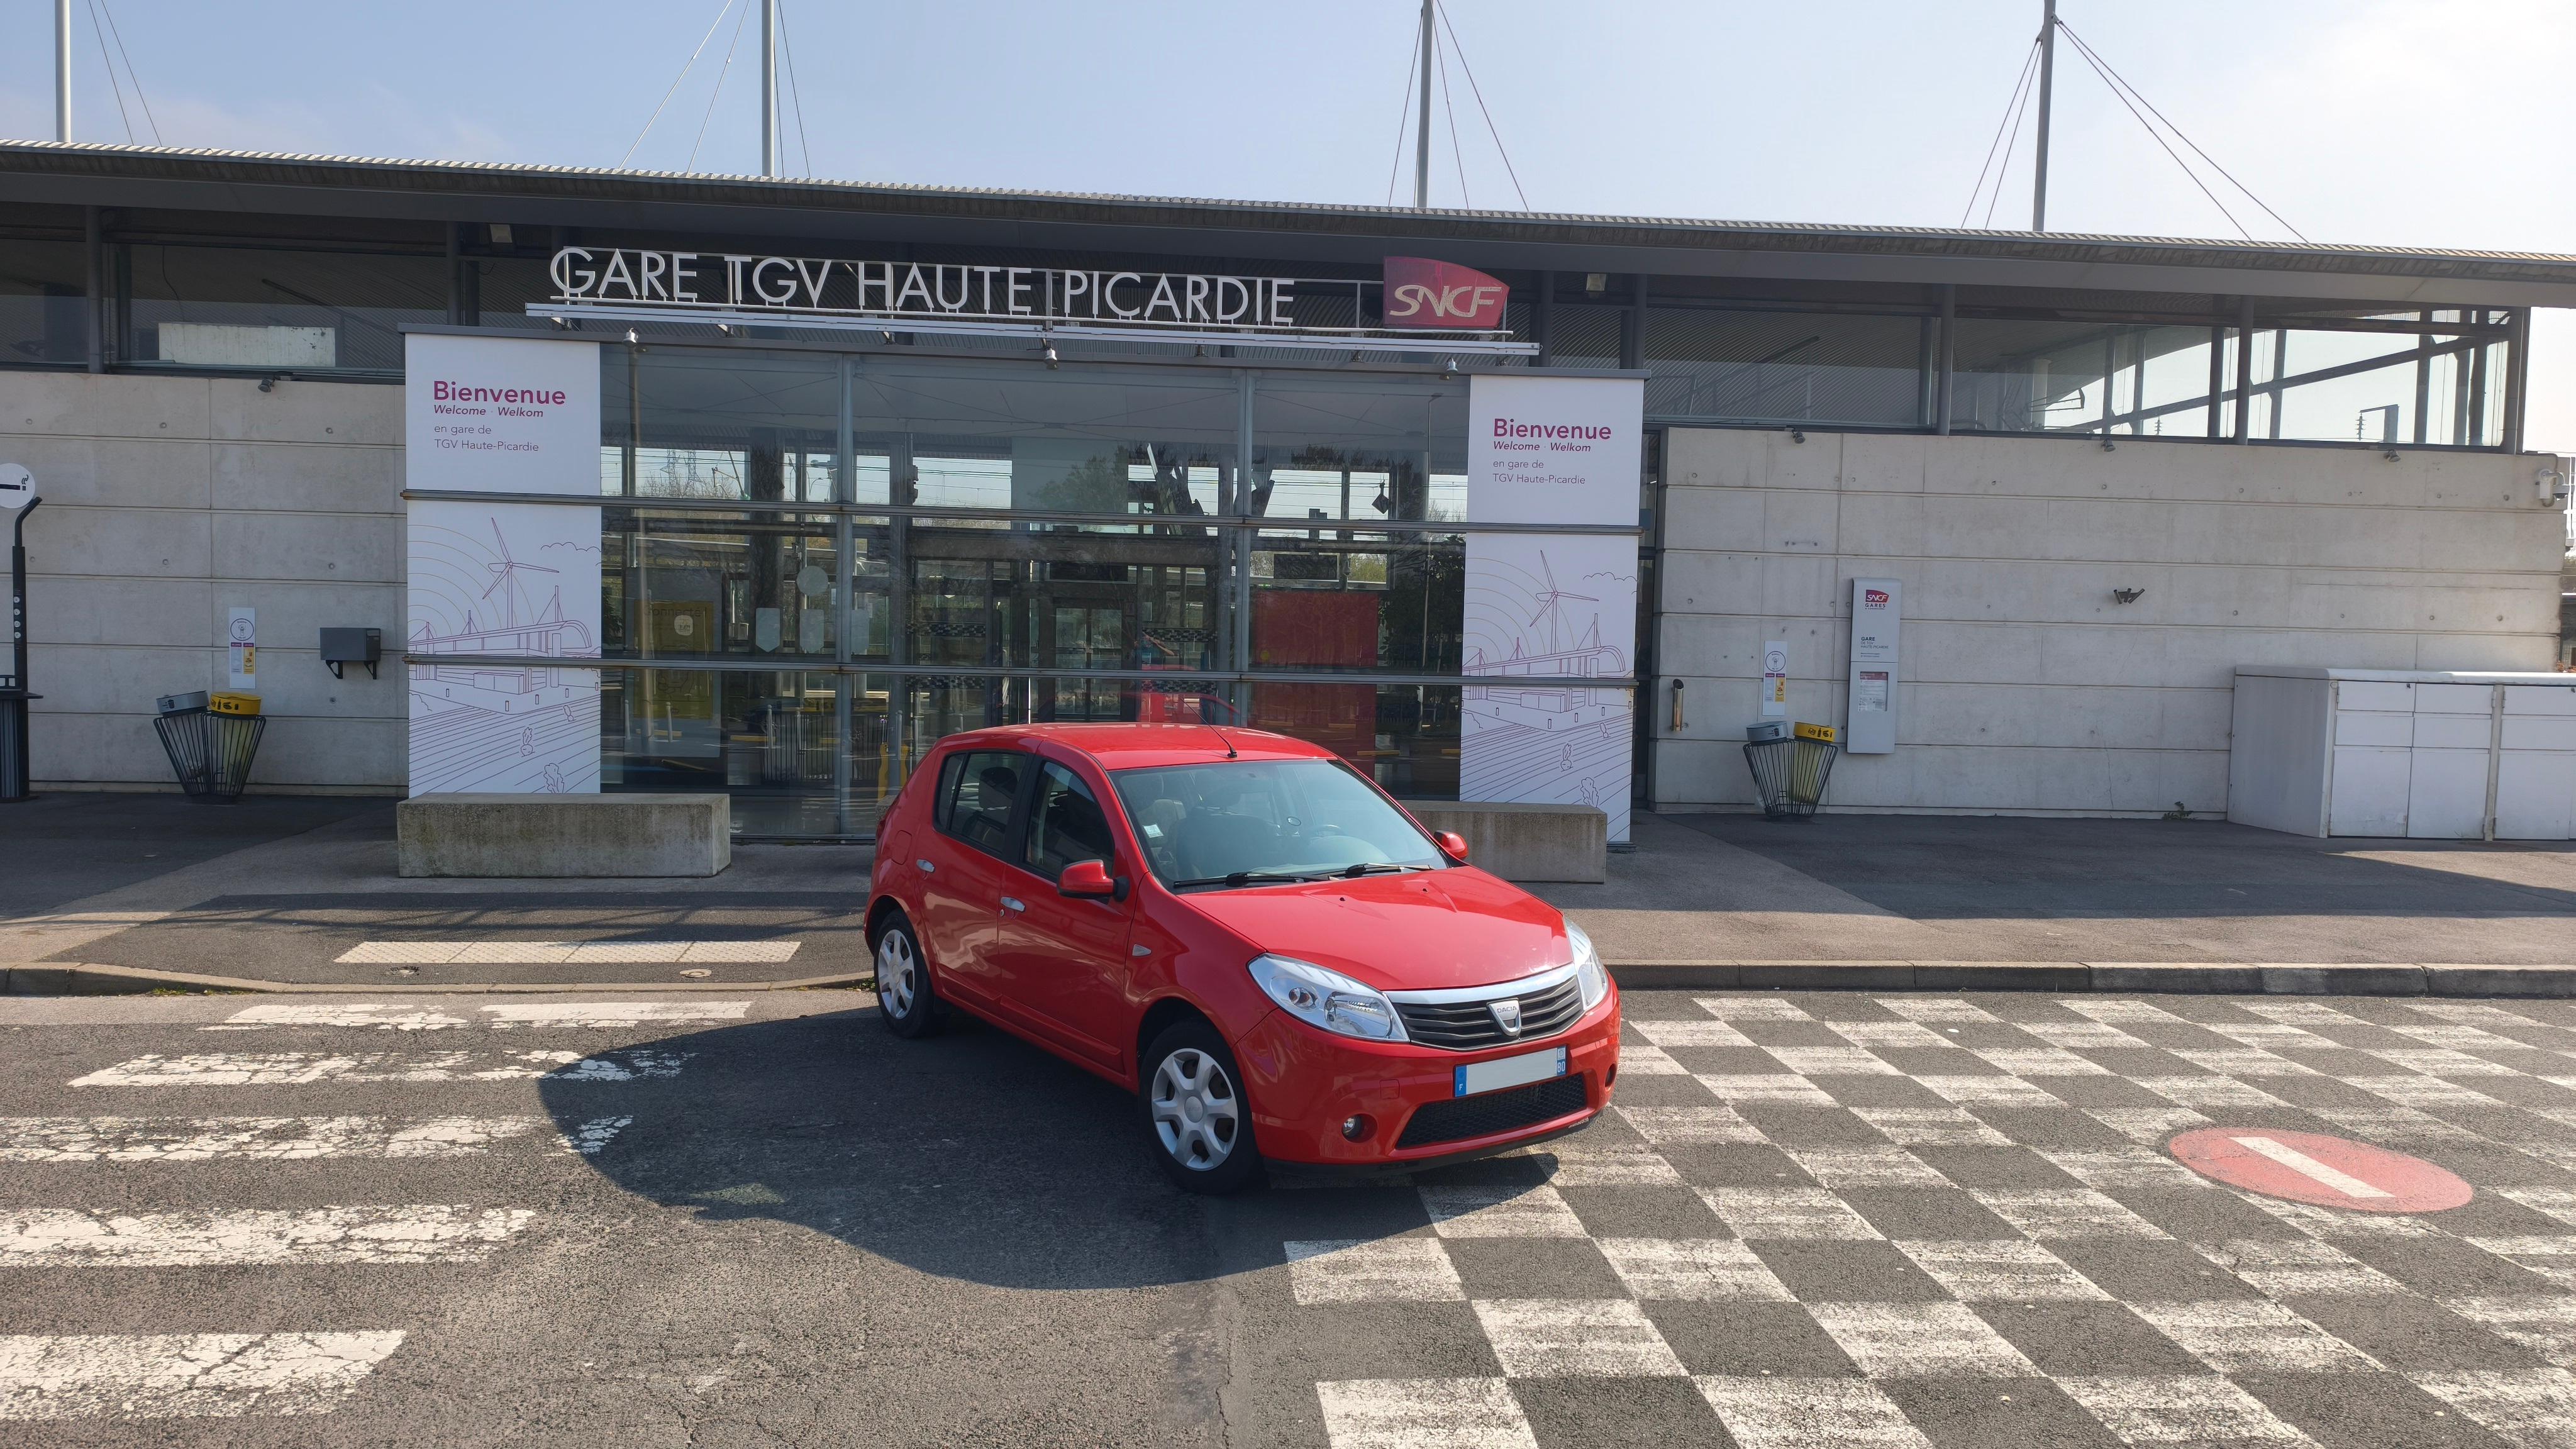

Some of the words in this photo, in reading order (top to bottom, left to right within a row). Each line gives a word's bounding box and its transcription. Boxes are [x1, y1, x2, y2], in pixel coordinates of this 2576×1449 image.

[550, 248, 697, 299] GARE
[724, 255, 832, 306] TGV
[859, 262, 1032, 313] HAUTE
[1065, 270, 1294, 323] PICARDIE
[1389, 284, 1501, 318] SNCF
[434, 380, 566, 404] Bienvenue
[434, 404, 486, 415] Welcome
[497, 406, 543, 417] Welkom
[451, 426, 474, 435] gare
[478, 425, 492, 434] de
[1494, 418, 1611, 440] Bienvenue
[434, 439, 458, 448] TGV
[462, 440, 539, 452] Haute-Picardie
[1493, 441, 1540, 450] Welcome
[1550, 442, 1591, 452] Welkom
[1507, 461, 1529, 470] gare
[1531, 460, 1544, 468] de
[1493, 473, 1514, 482] TGV
[1517, 474, 1585, 484] Haute-Picardie
[1557, 1061, 1565, 1072] 80
